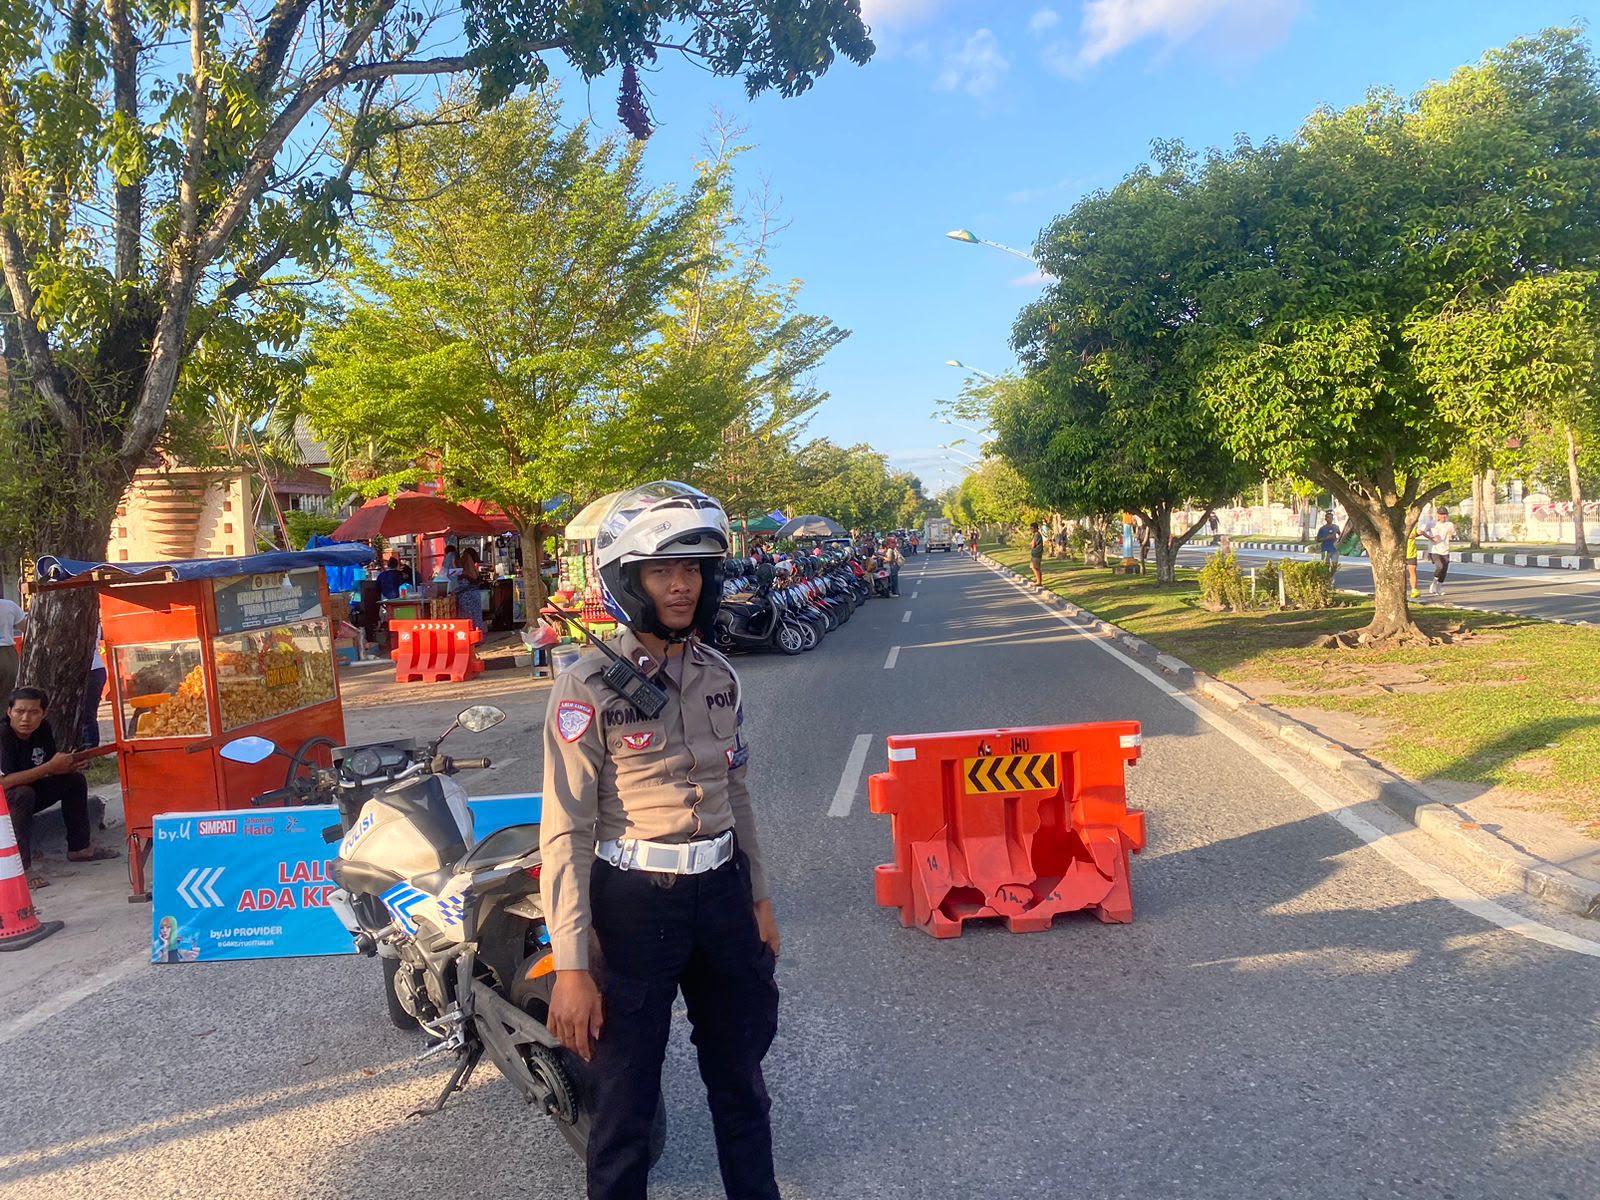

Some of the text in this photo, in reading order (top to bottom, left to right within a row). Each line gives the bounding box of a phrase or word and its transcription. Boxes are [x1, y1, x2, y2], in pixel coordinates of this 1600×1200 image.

[158, 821, 191, 842] by.U
[199, 819, 236, 835] SIMPATI
[244, 823, 274, 836] Halo
[237, 887, 296, 912] ADA
[210, 926, 283, 939] by.U PROVIDER
